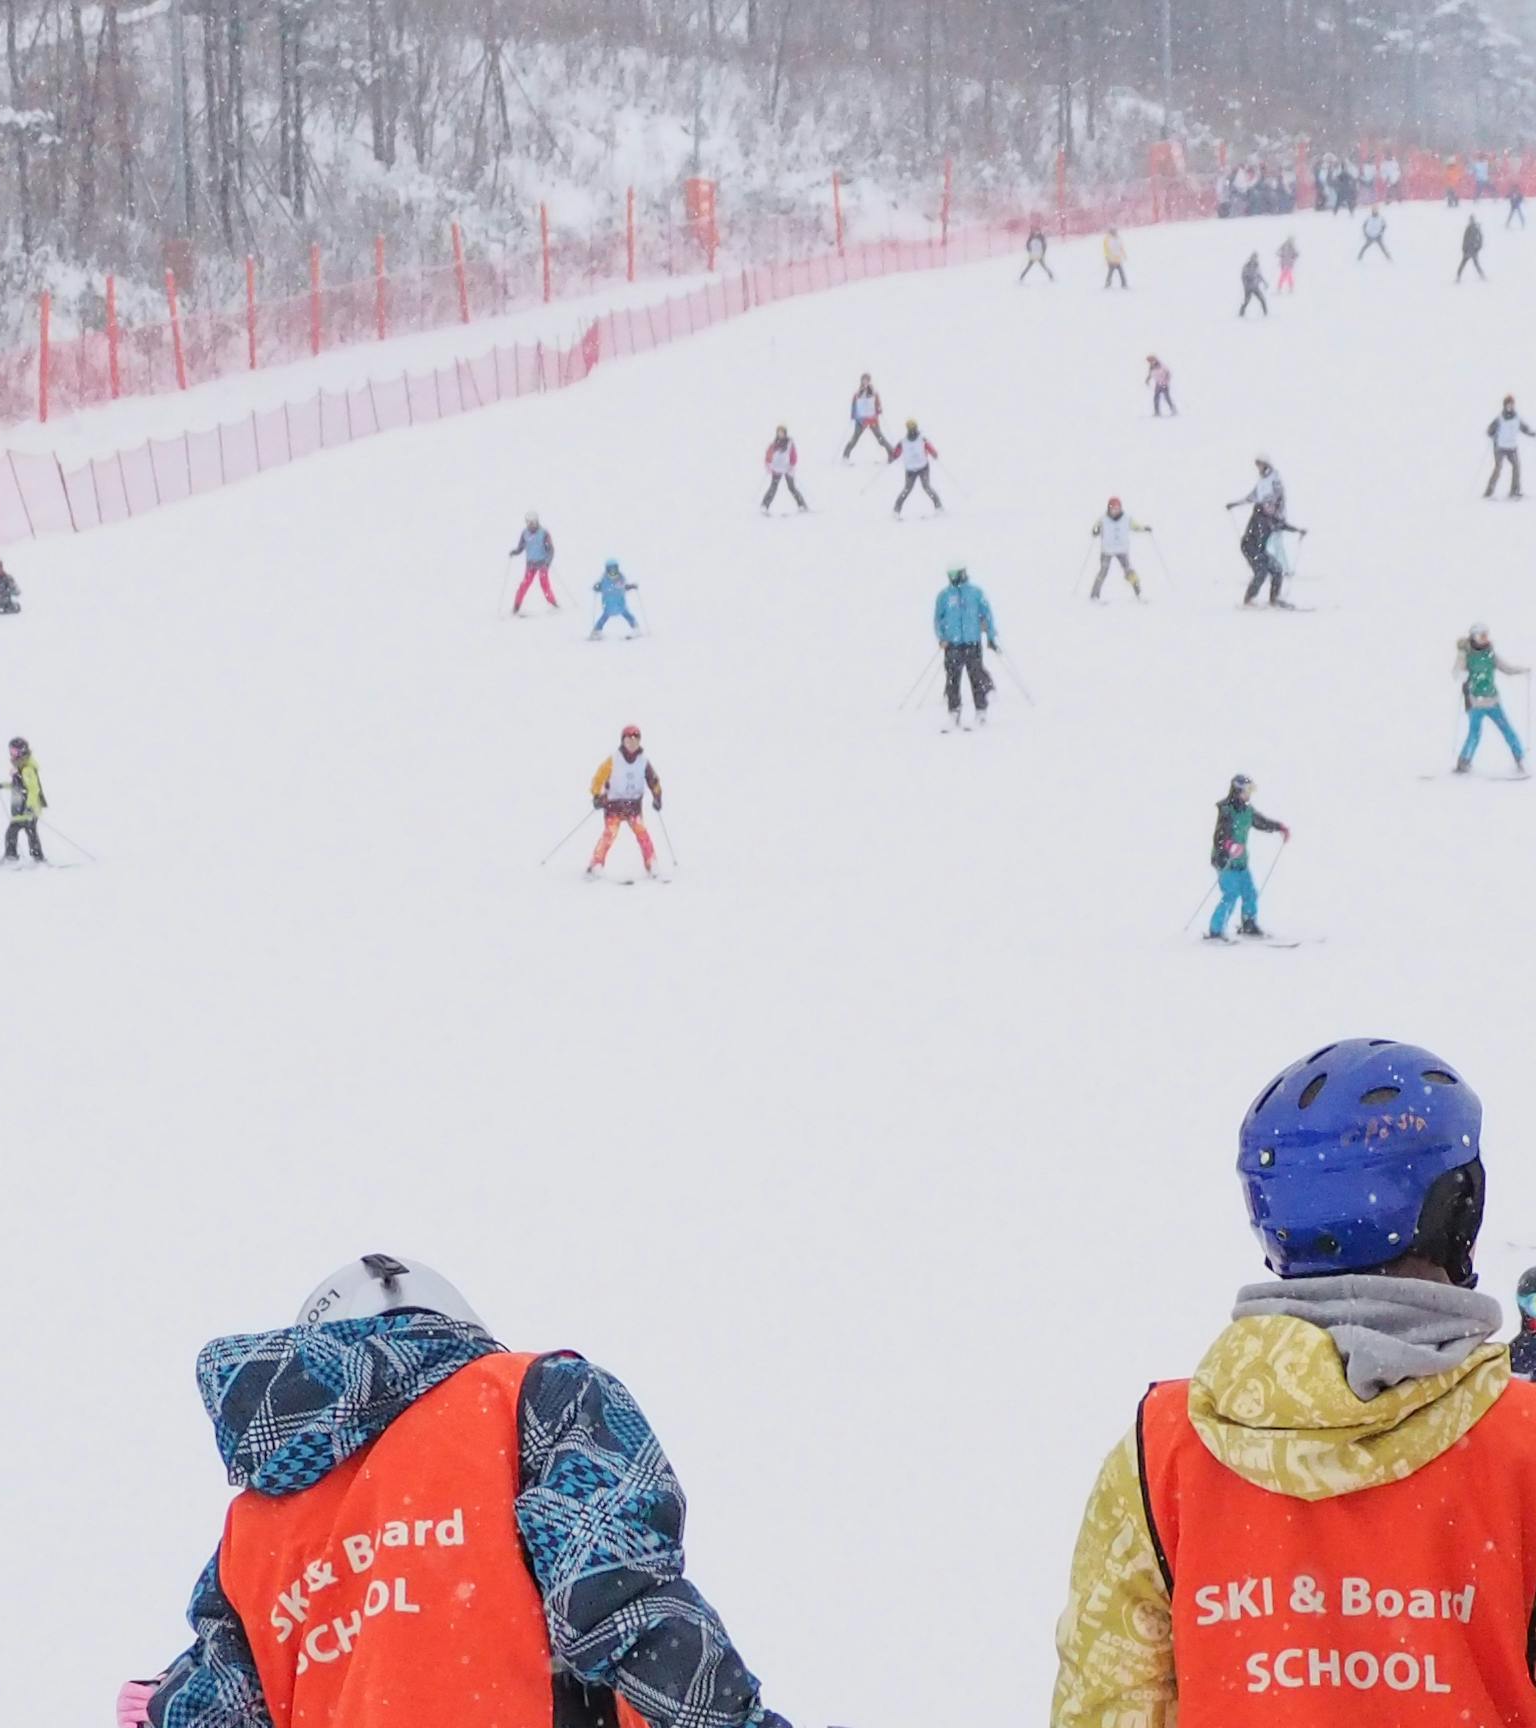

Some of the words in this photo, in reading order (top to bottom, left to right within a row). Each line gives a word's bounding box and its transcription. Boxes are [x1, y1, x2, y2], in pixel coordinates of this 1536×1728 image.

[271, 1579, 311, 1644] SK
[302, 1559, 339, 1593] &
[342, 1507, 465, 1574] Bard
[1195, 1576, 1275, 1626] SKI
[1289, 1574, 1327, 1615] &
[1341, 1577, 1476, 1624] Board
[296, 1577, 421, 1676] CHOL
[1246, 1647, 1452, 1694] SCHOOL
